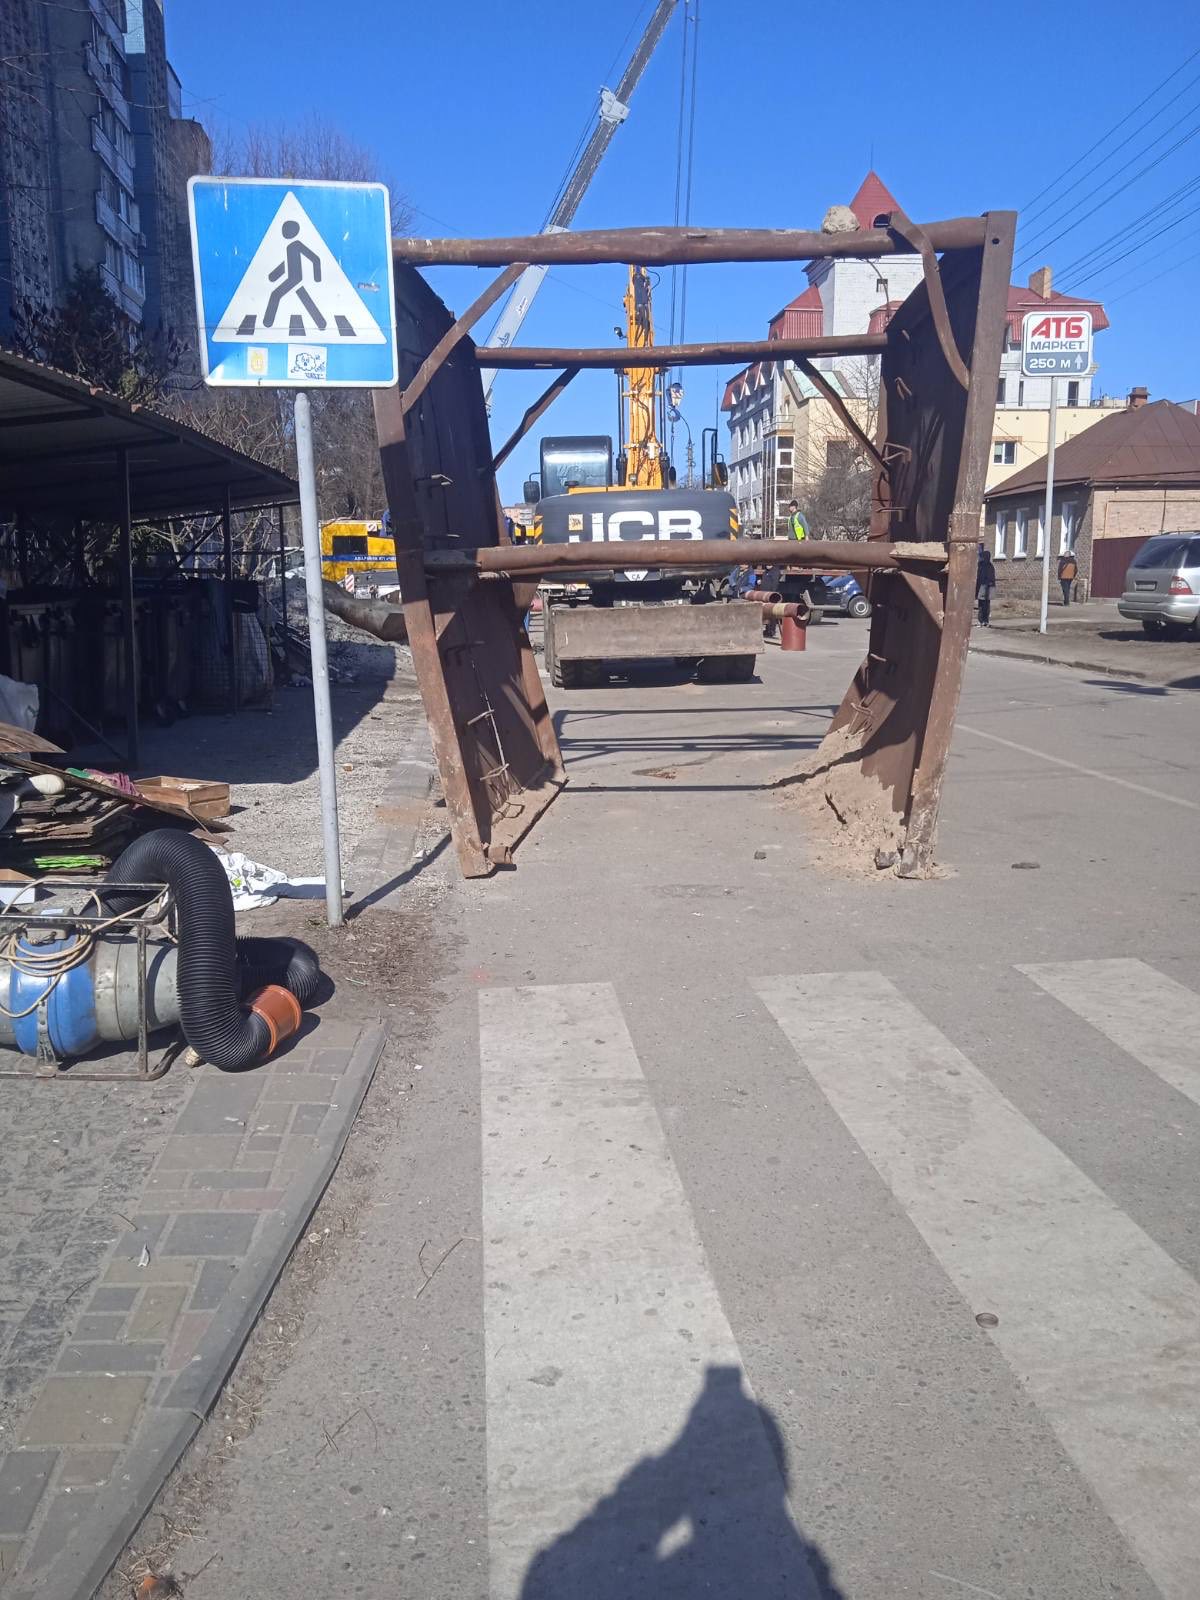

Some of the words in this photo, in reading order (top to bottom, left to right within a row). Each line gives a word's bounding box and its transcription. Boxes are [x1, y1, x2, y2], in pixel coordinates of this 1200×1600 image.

[1031, 317, 1086, 338] АТБ
[1031, 341, 1085, 350] МАРКЕТ
[1029, 359, 1056, 369] 250
